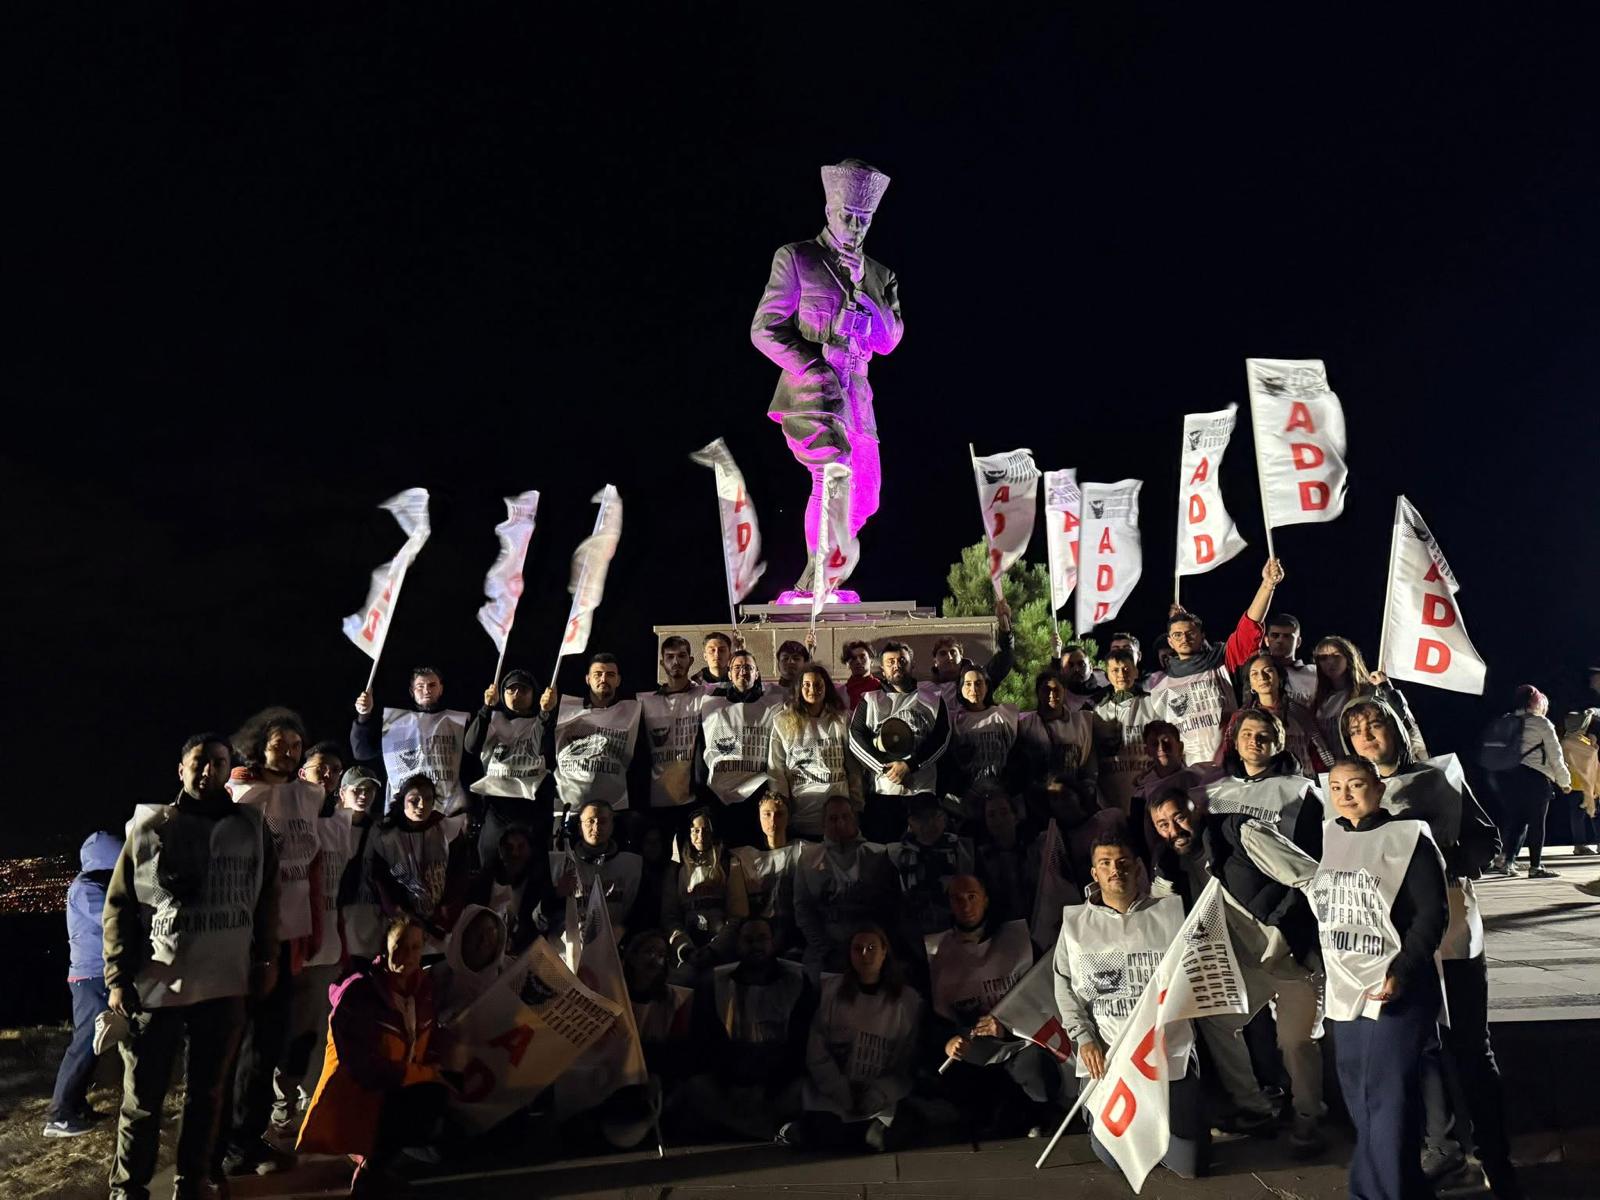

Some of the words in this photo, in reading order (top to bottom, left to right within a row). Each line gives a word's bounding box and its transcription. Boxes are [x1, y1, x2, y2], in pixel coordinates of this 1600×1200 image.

[1189, 456, 1216, 565] ADD
[1285, 401, 1330, 511] ADD
[1330, 930, 1385, 956] KOLLARI
